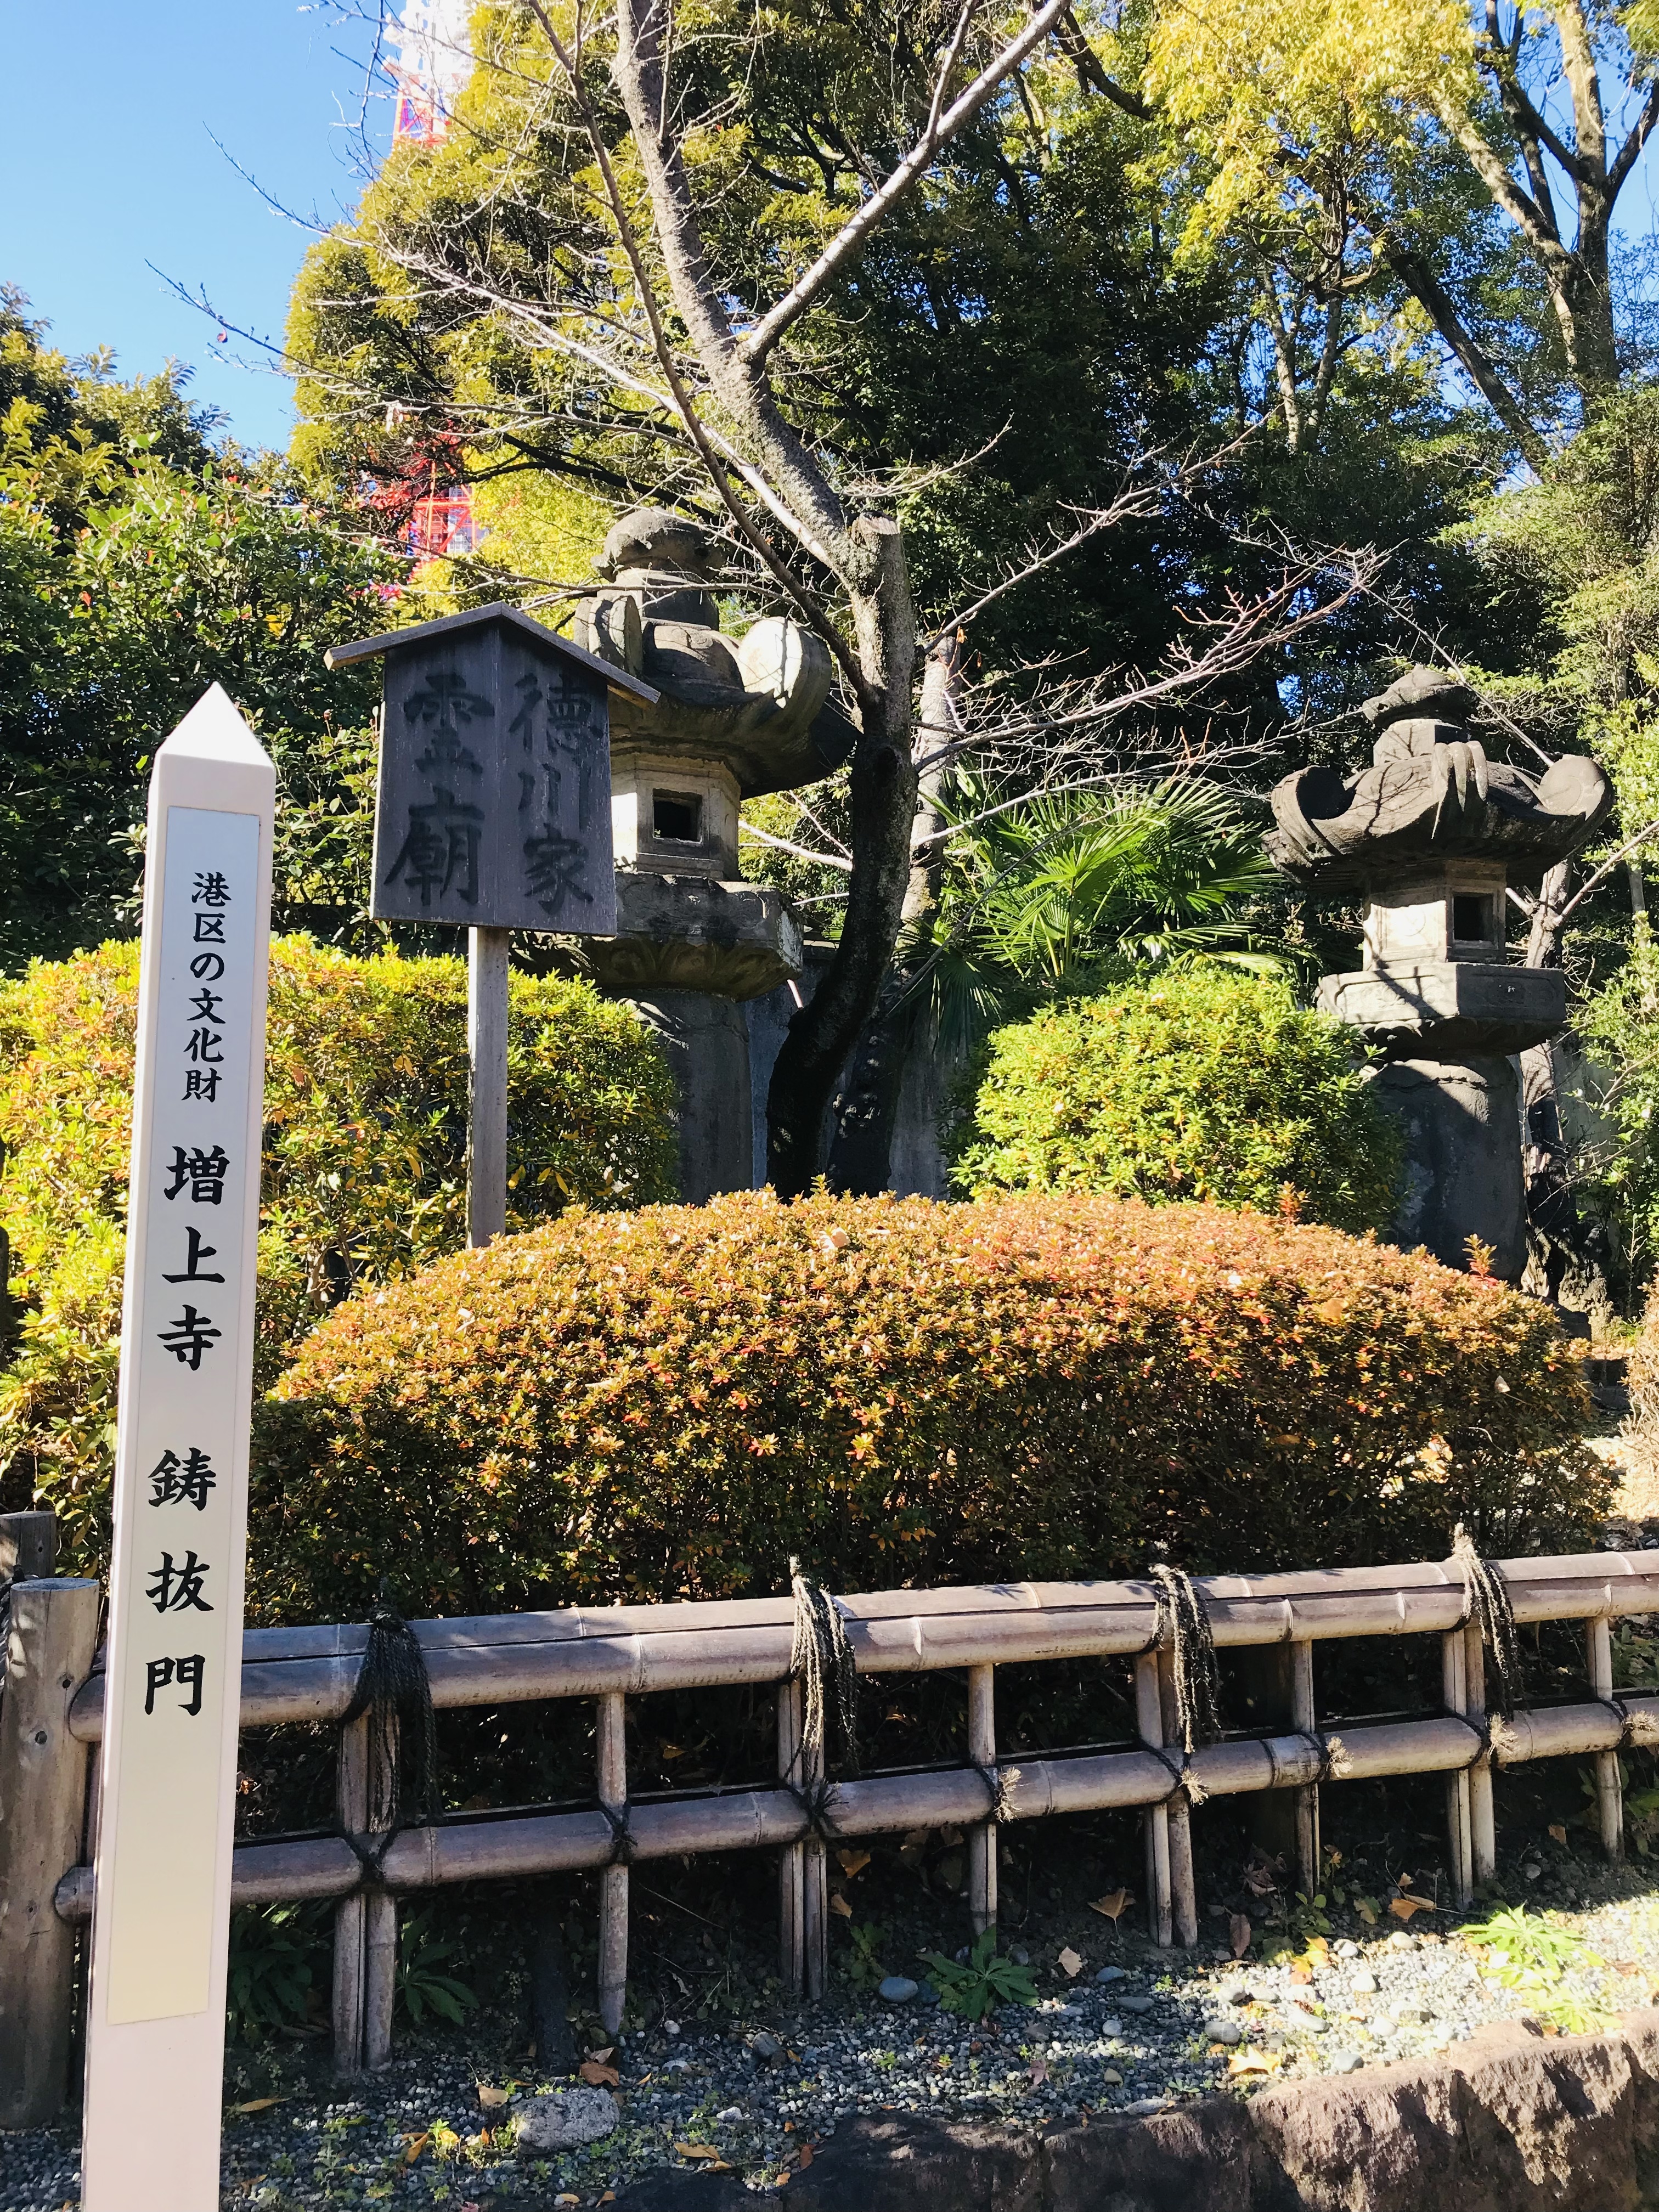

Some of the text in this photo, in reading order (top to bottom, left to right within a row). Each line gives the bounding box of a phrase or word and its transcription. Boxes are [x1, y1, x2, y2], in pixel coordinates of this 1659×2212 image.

[180, 871, 232, 1103] 港区の文化財
[144, 1144, 231, 1717] 増上寺 鋳抜門
